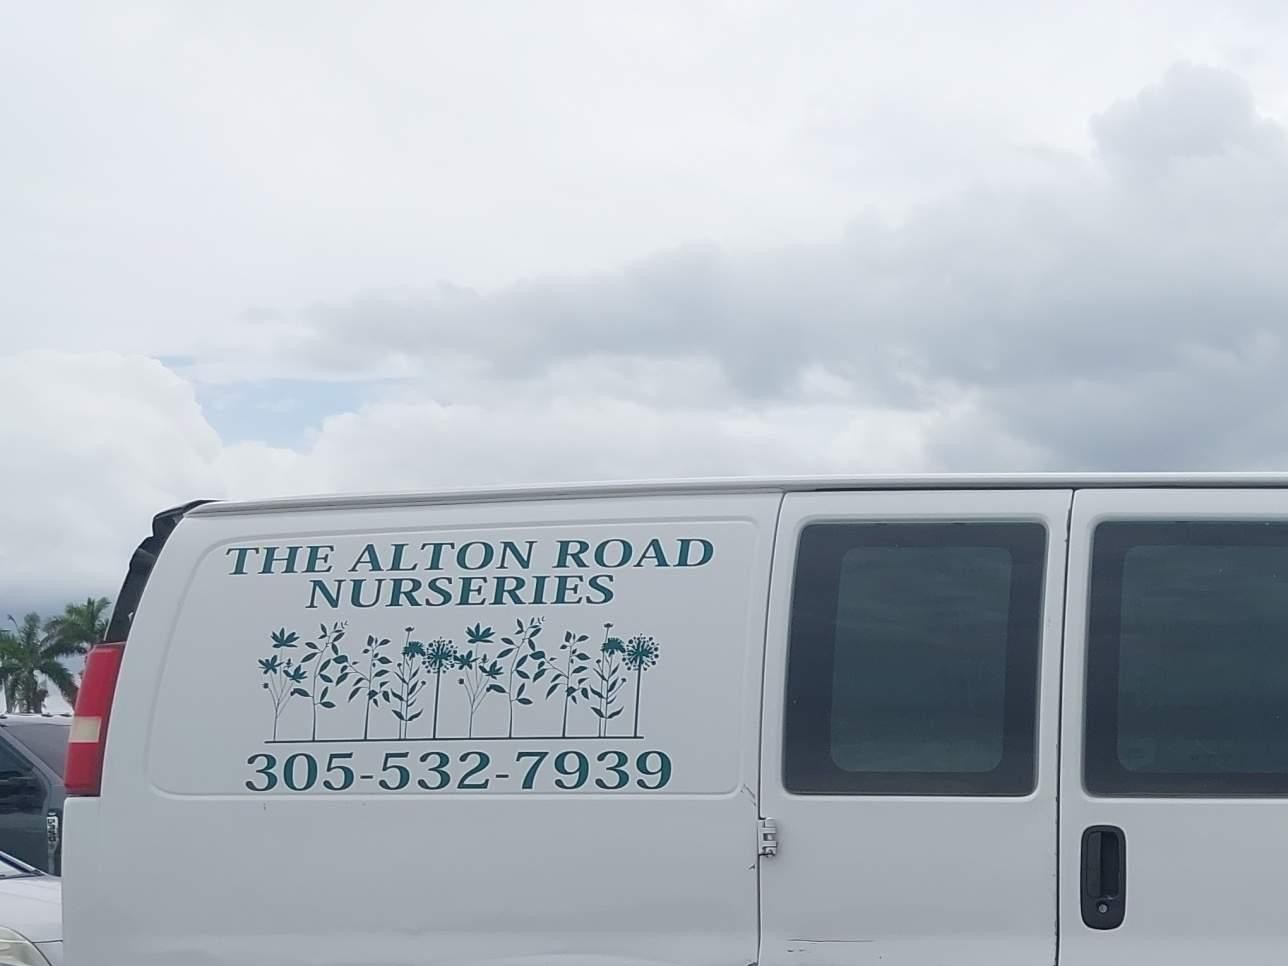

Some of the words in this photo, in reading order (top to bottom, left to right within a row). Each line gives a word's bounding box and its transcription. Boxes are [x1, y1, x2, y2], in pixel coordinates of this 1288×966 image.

[225, 545, 335, 575] THE
[347, 541, 538, 573] ALTON
[553, 538, 714, 570] ROAD
[305, 574, 614, 609] NURSERIES
[245, 751, 672, 792] 305-532-7939
